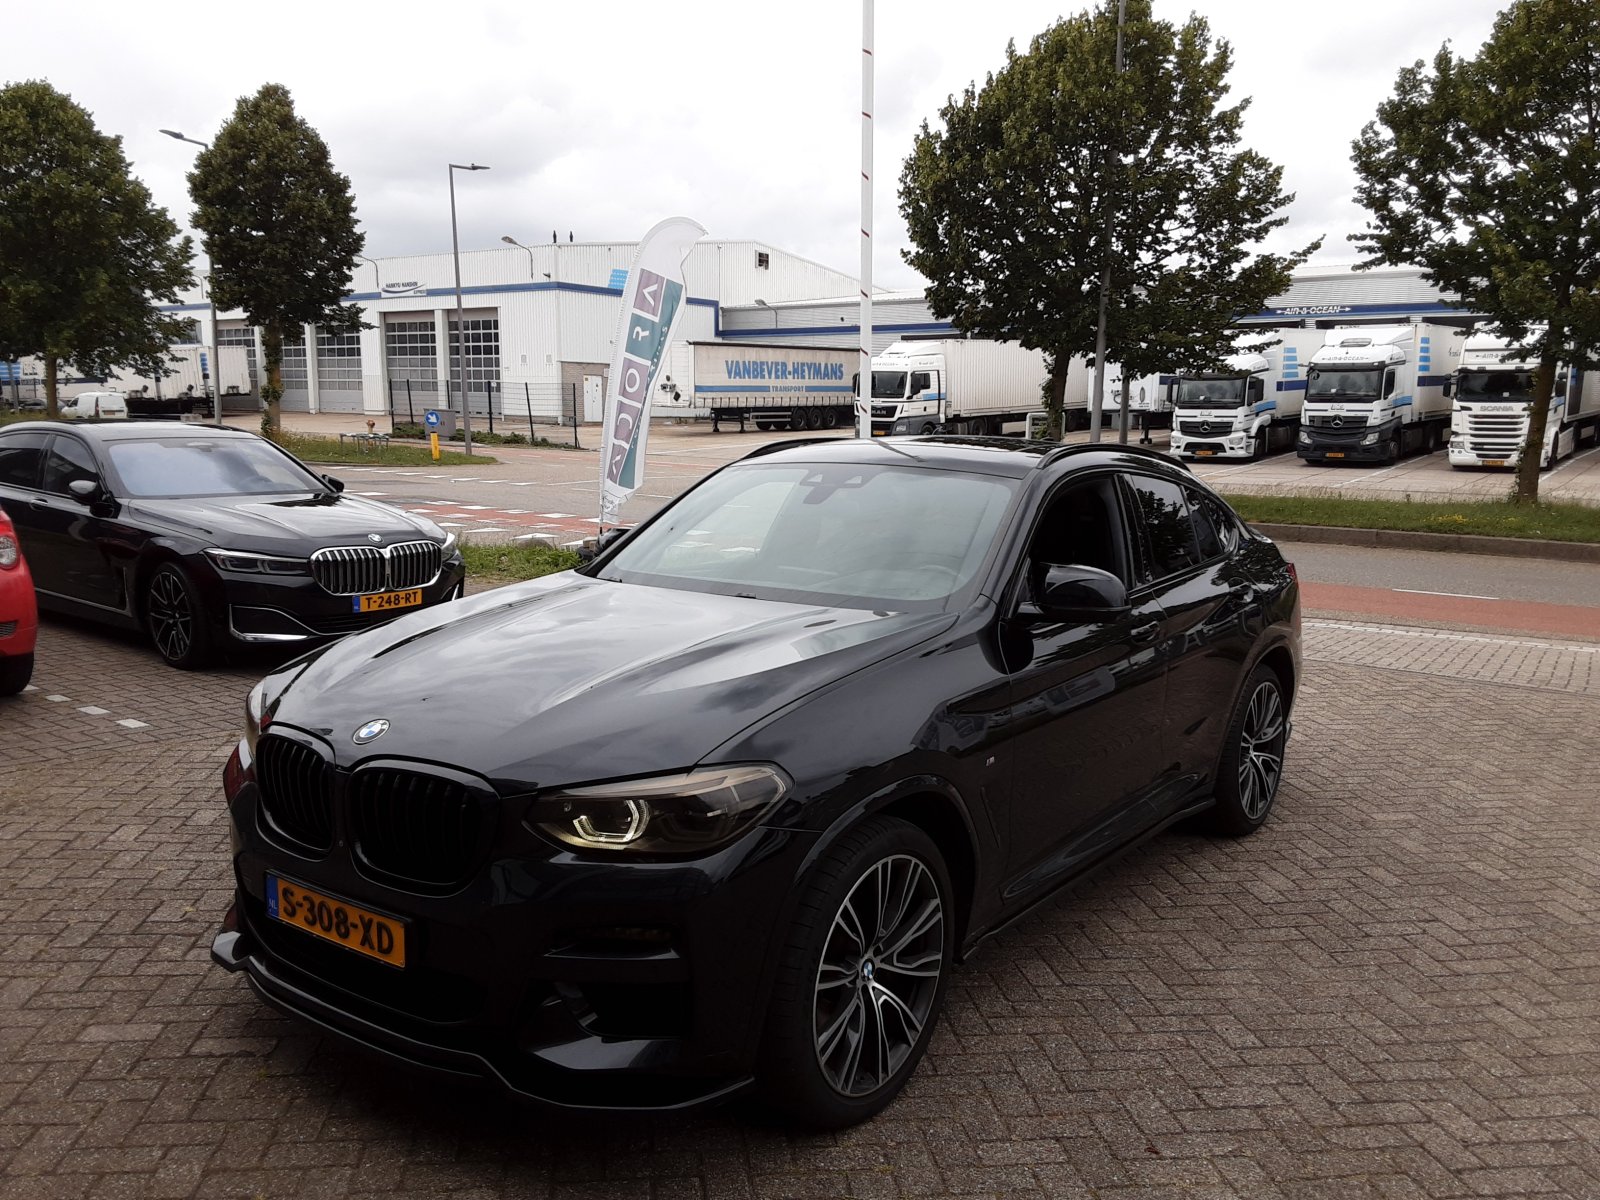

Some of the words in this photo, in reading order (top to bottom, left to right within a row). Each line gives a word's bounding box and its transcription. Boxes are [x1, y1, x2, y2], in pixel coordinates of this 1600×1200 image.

[1284, 307, 1299, 315] AIR
[1309, 305, 1341, 315] OCEAN
[725, 360, 844, 381] VANBEVER-HEYMANS
[771, 385, 806, 393] TRANSPORT
[365, 591, 419, 610] T-248-RT
[281, 886, 395, 956] S-308-XD
